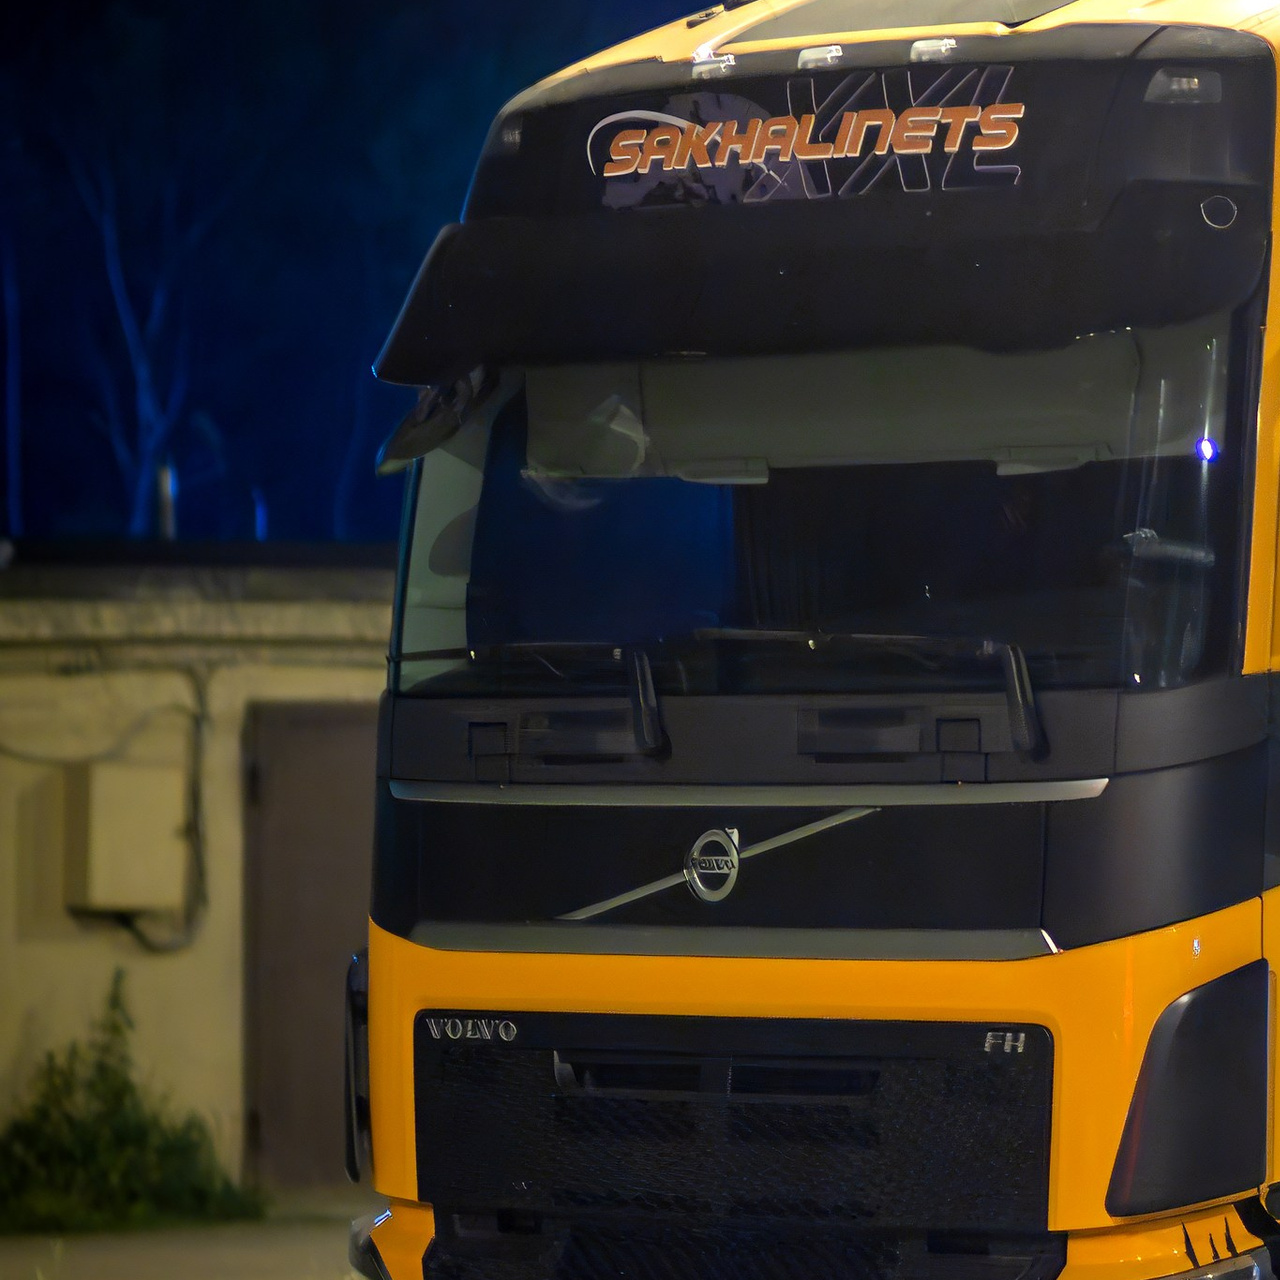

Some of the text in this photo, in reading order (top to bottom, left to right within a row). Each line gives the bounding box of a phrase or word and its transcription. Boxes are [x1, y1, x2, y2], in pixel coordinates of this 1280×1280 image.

[603, 102, 1026, 177] SAKHALINETS
[425, 1018, 518, 1042] VOLVO
[984, 1031, 1026, 1053] FH
